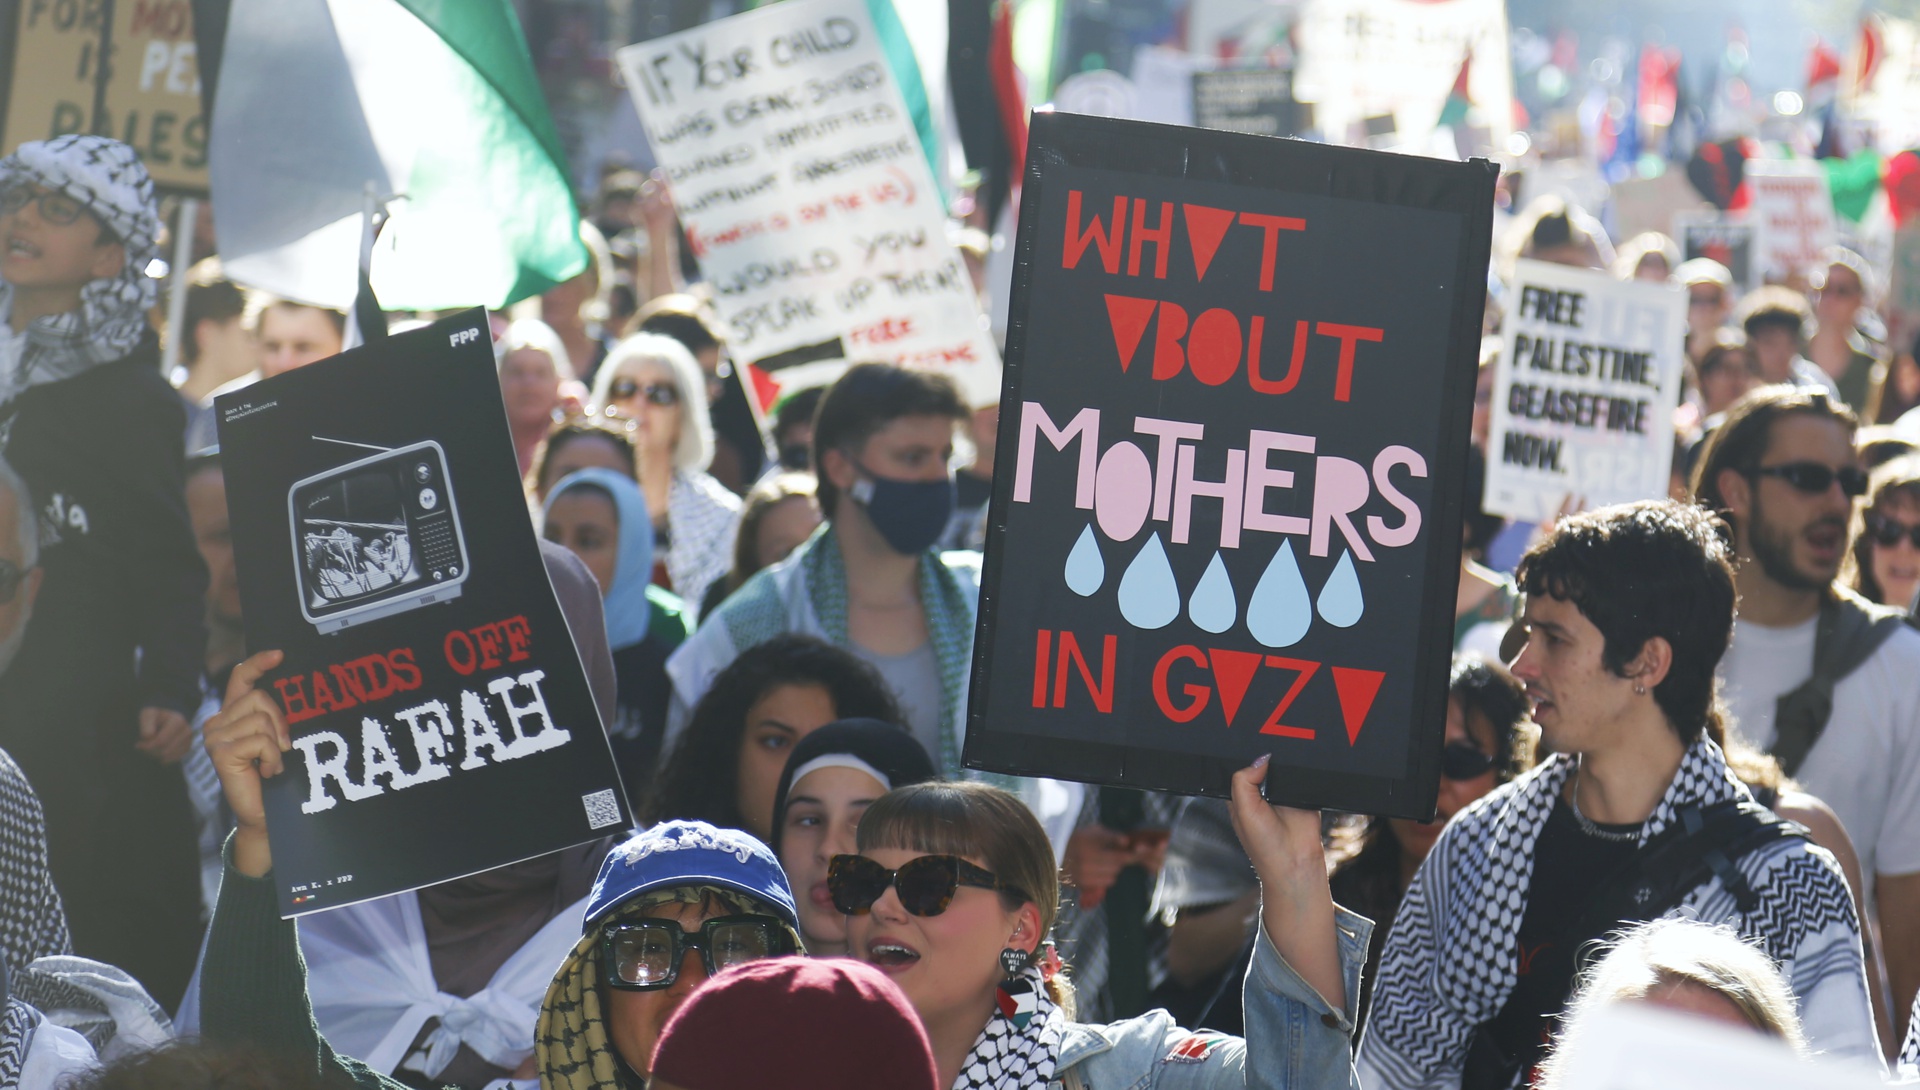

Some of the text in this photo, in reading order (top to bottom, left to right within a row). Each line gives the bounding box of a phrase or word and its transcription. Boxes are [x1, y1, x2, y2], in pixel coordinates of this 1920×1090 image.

[129, 0, 194, 39] MO
[139, 40, 202, 94] PE
[637, 17, 861, 105] IF YOUR CHILD
[855, 226, 927, 266] YOU
[731, 296, 819, 343] SPEAK
[837, 276, 875, 311] UP
[1518, 285, 1587, 329] FREE
[449, 327, 480, 348] FPP
[1508, 382, 1650, 434] CEASEFIRE
[1502, 430, 1567, 475] NOW.
[1013, 401, 1428, 562] MOTHERS
[274, 615, 531, 724] HANDS OFF
[1032, 629, 1118, 714] IN
[292, 670, 571, 815] RAFAH
[291, 885, 308, 893] Awn
[1002, 951, 1027, 960] ALWAYS
